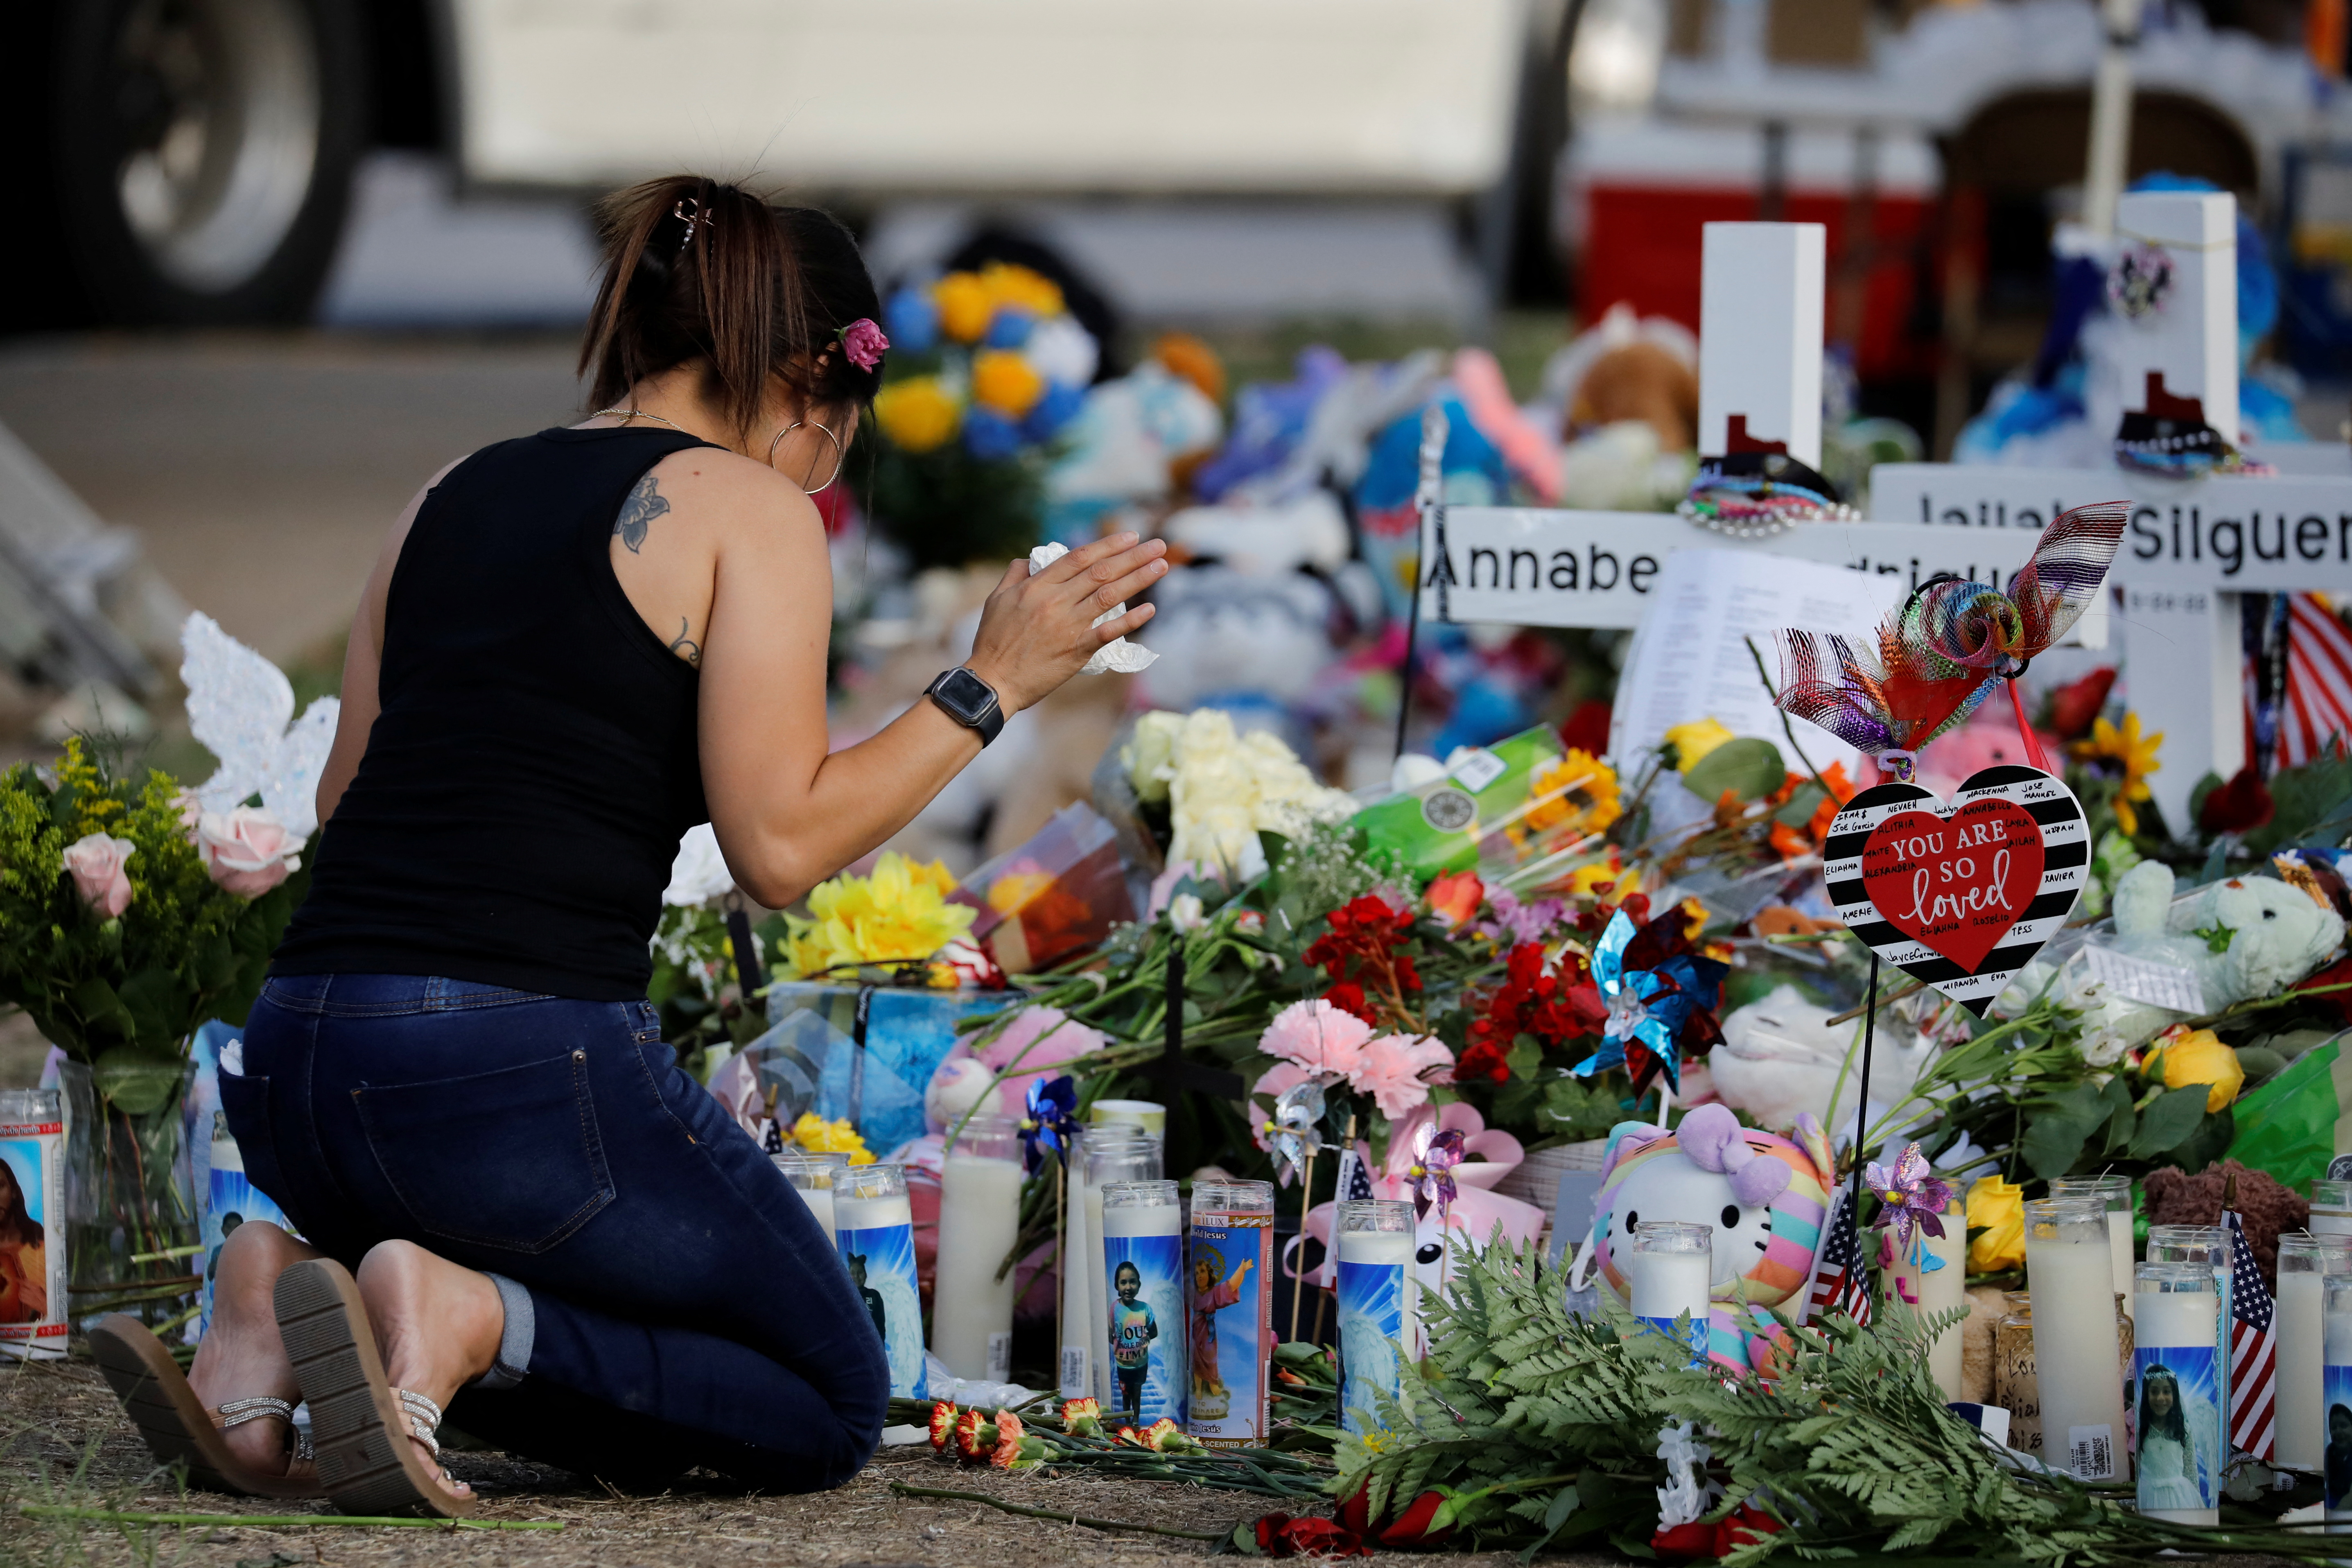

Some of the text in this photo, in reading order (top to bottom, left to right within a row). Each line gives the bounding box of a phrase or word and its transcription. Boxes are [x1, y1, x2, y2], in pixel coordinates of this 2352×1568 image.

[1427, 536, 1659, 593] Annabe
[1966, 786, 2009, 800] MACKENNA
[1888, 800, 1916, 813] NEVAEH
[1963, 802, 2011, 817] ANNABELLE
[1837, 811, 1859, 821] IRMA
[2006, 818, 2029, 827] LAYLA
[1852, 821, 1874, 831] Garcia
[1878, 819, 1915, 835] ALITHIA
[1891, 820, 2007, 861] YOU ARE
[2002, 835, 2035, 849] JAILAH
[1864, 846, 1889, 859] MAITE
[1826, 863, 1858, 875] ELIAHNA
[1865, 862, 1916, 879] ALEXANDRIA
[1940, 858, 1975, 883] SO
[2045, 871, 2074, 883] XAVIER
[1899, 849, 2012, 926] loved
[1842, 907, 1872, 920] AMERIE
[1920, 922, 1959, 937] ELIAHNA
[2011, 924, 2032, 936] TESS
[1943, 977, 1979, 990] MIRANDA
[1991, 973, 2006, 981] EVA
[1188, 1422, 1221, 1433] iño Jesús
